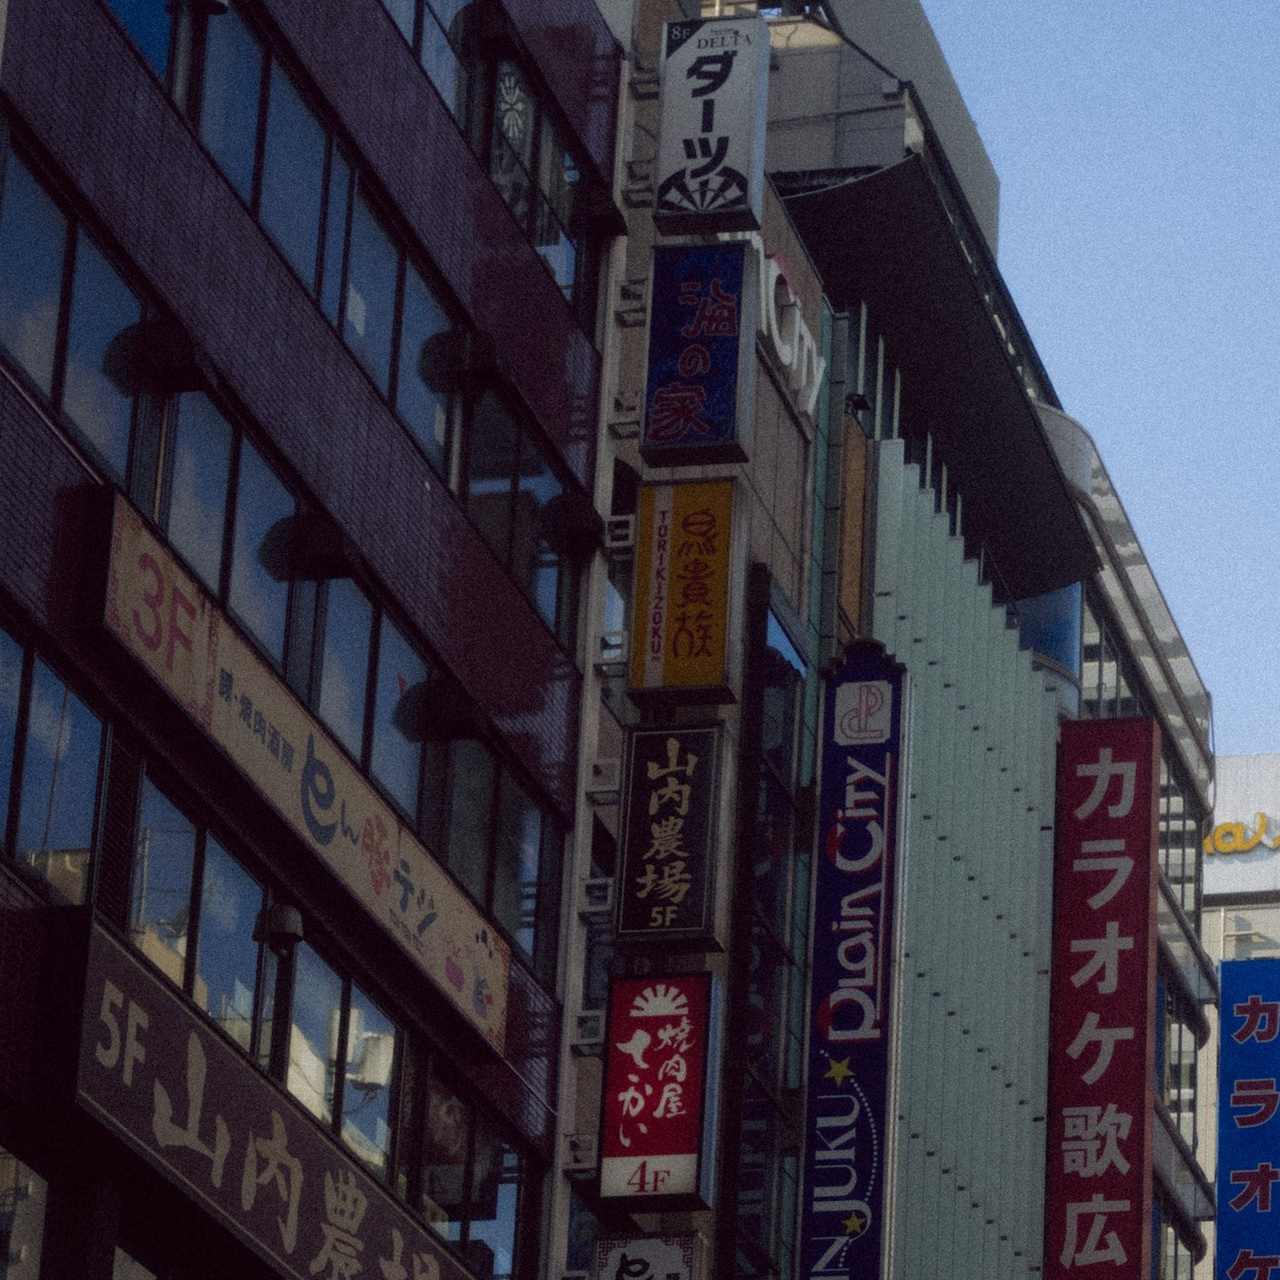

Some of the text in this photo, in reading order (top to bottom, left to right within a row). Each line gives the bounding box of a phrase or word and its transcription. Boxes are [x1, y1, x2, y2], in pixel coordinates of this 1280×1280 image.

[671, 26, 690, 41] 8F
[696, 35, 752, 50] DELTA
[683, 50, 738, 179] ダーツ
[652, 278, 738, 440] 海の家
[132, 552, 197, 672] 3F
[650, 510, 669, 655] TORIKIZOKU
[635, 737, 699, 905] 山内農場
[648, 906, 680, 928] 5F
[95, 979, 149, 1088] 5F
[614, 1028, 655, 1149] さかい
[652, 1016, 696, 1119] 焼肉屋
[627, 1160, 671, 1193] 4F
